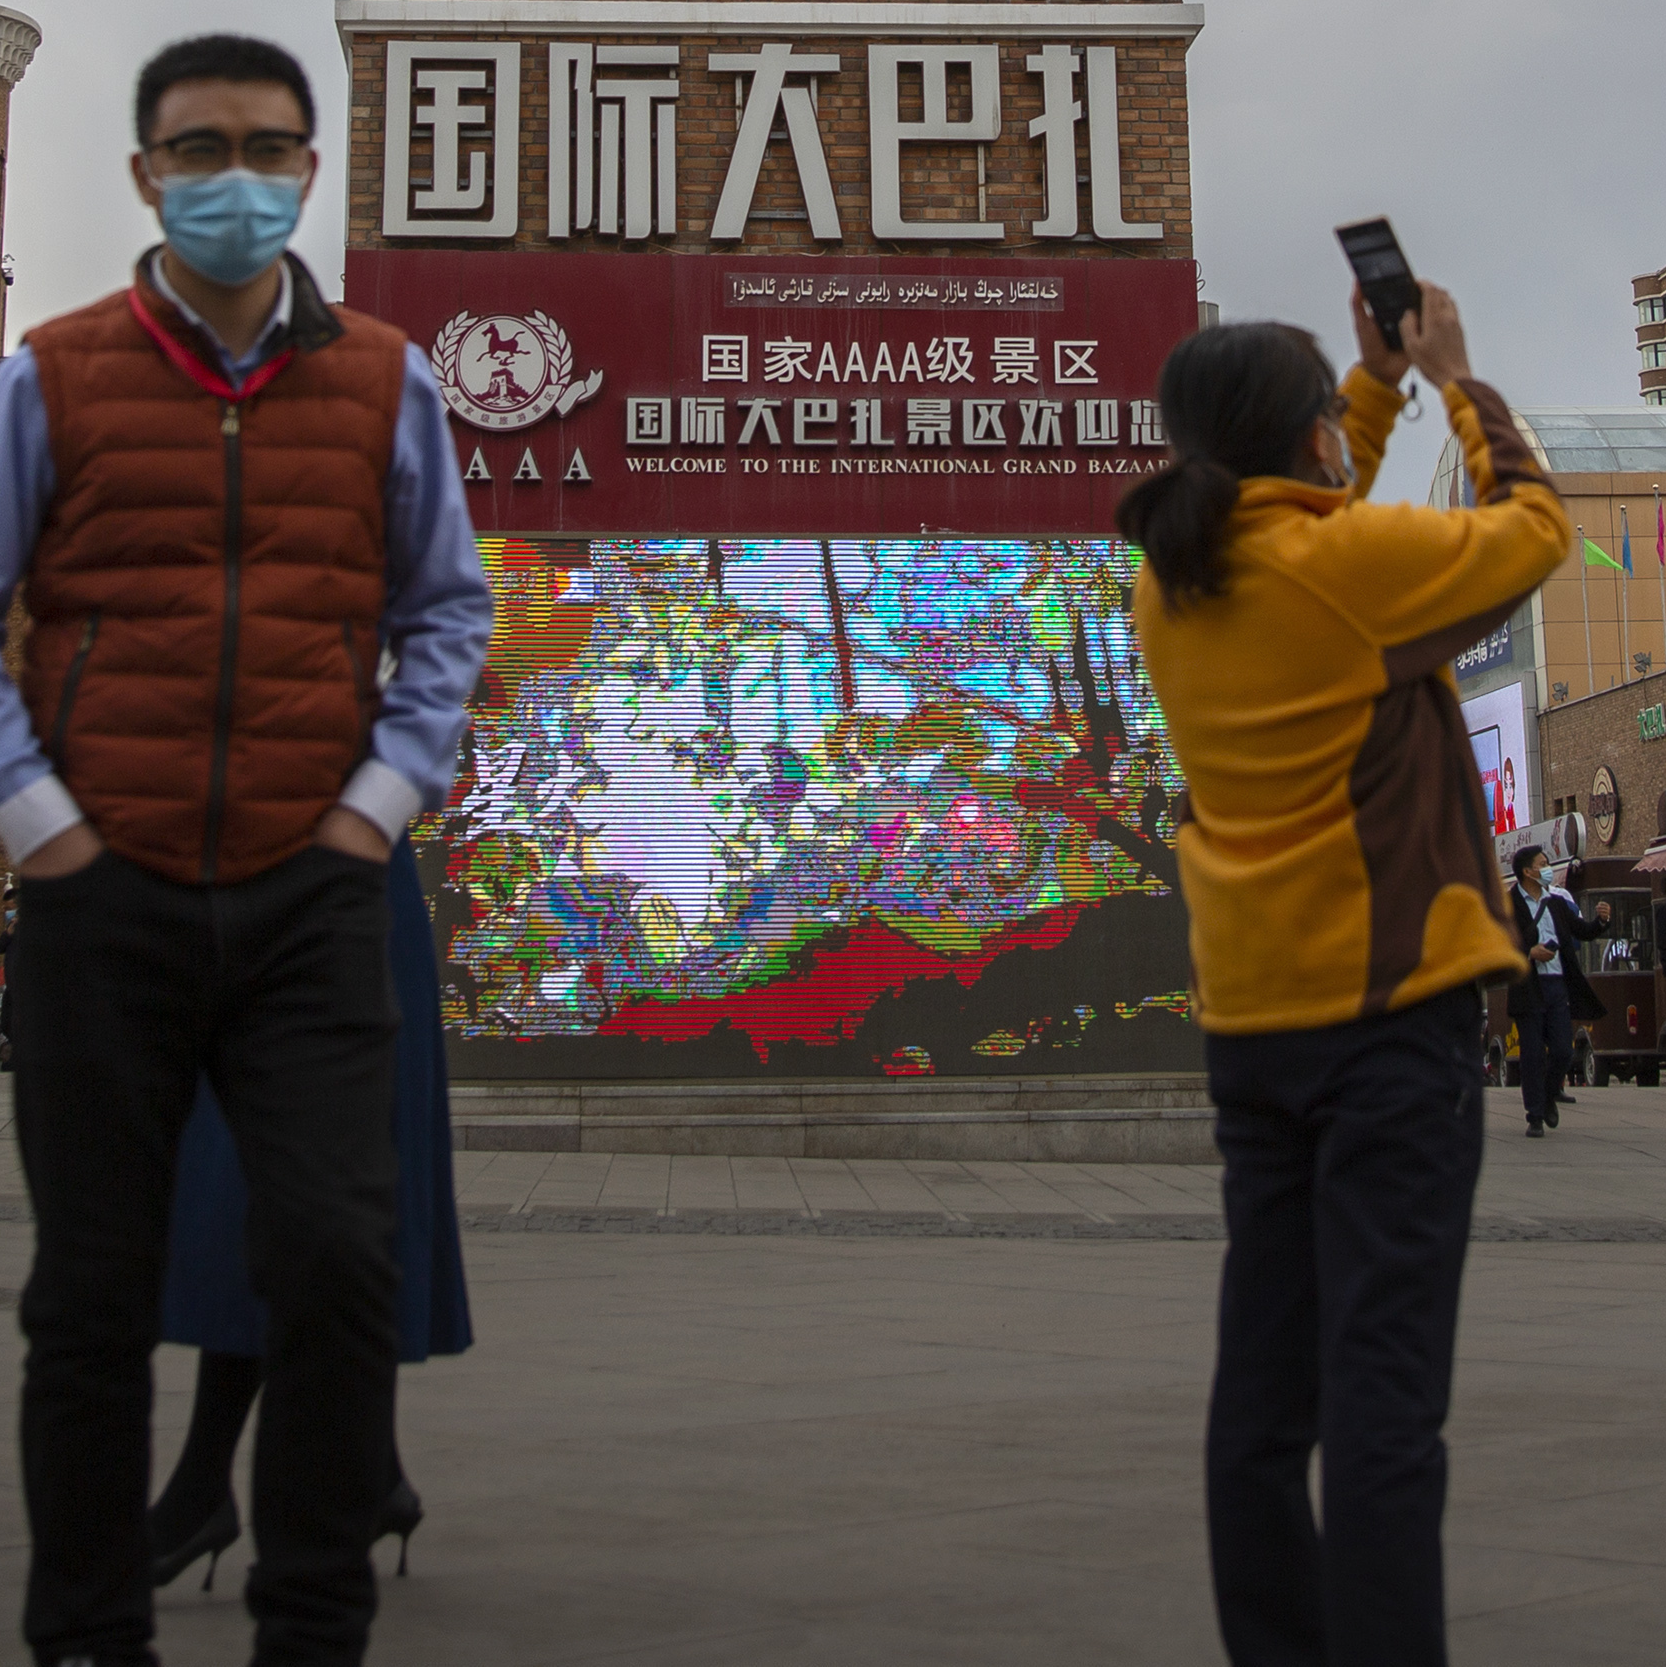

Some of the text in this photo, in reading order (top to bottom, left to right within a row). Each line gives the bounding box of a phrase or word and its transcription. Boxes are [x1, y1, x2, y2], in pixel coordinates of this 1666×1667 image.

[382, 40, 1164, 241] 国际大巴扎
[941, 280, 968, 304] بازار
[701, 334, 1100, 386] 国家AAAA级景区
[449, 392, 557, 426] 国家级旅游景区
[625, 396, 1173, 447] 国际大巴扎景区欢迎您
[625, 457, 727, 473] WELCOME
[740, 458, 769, 473] TO
[777, 458, 821, 474] THE
[830, 458, 995, 474] INTERNATIONAL
[1003, 458, 1077, 474] GRAND
